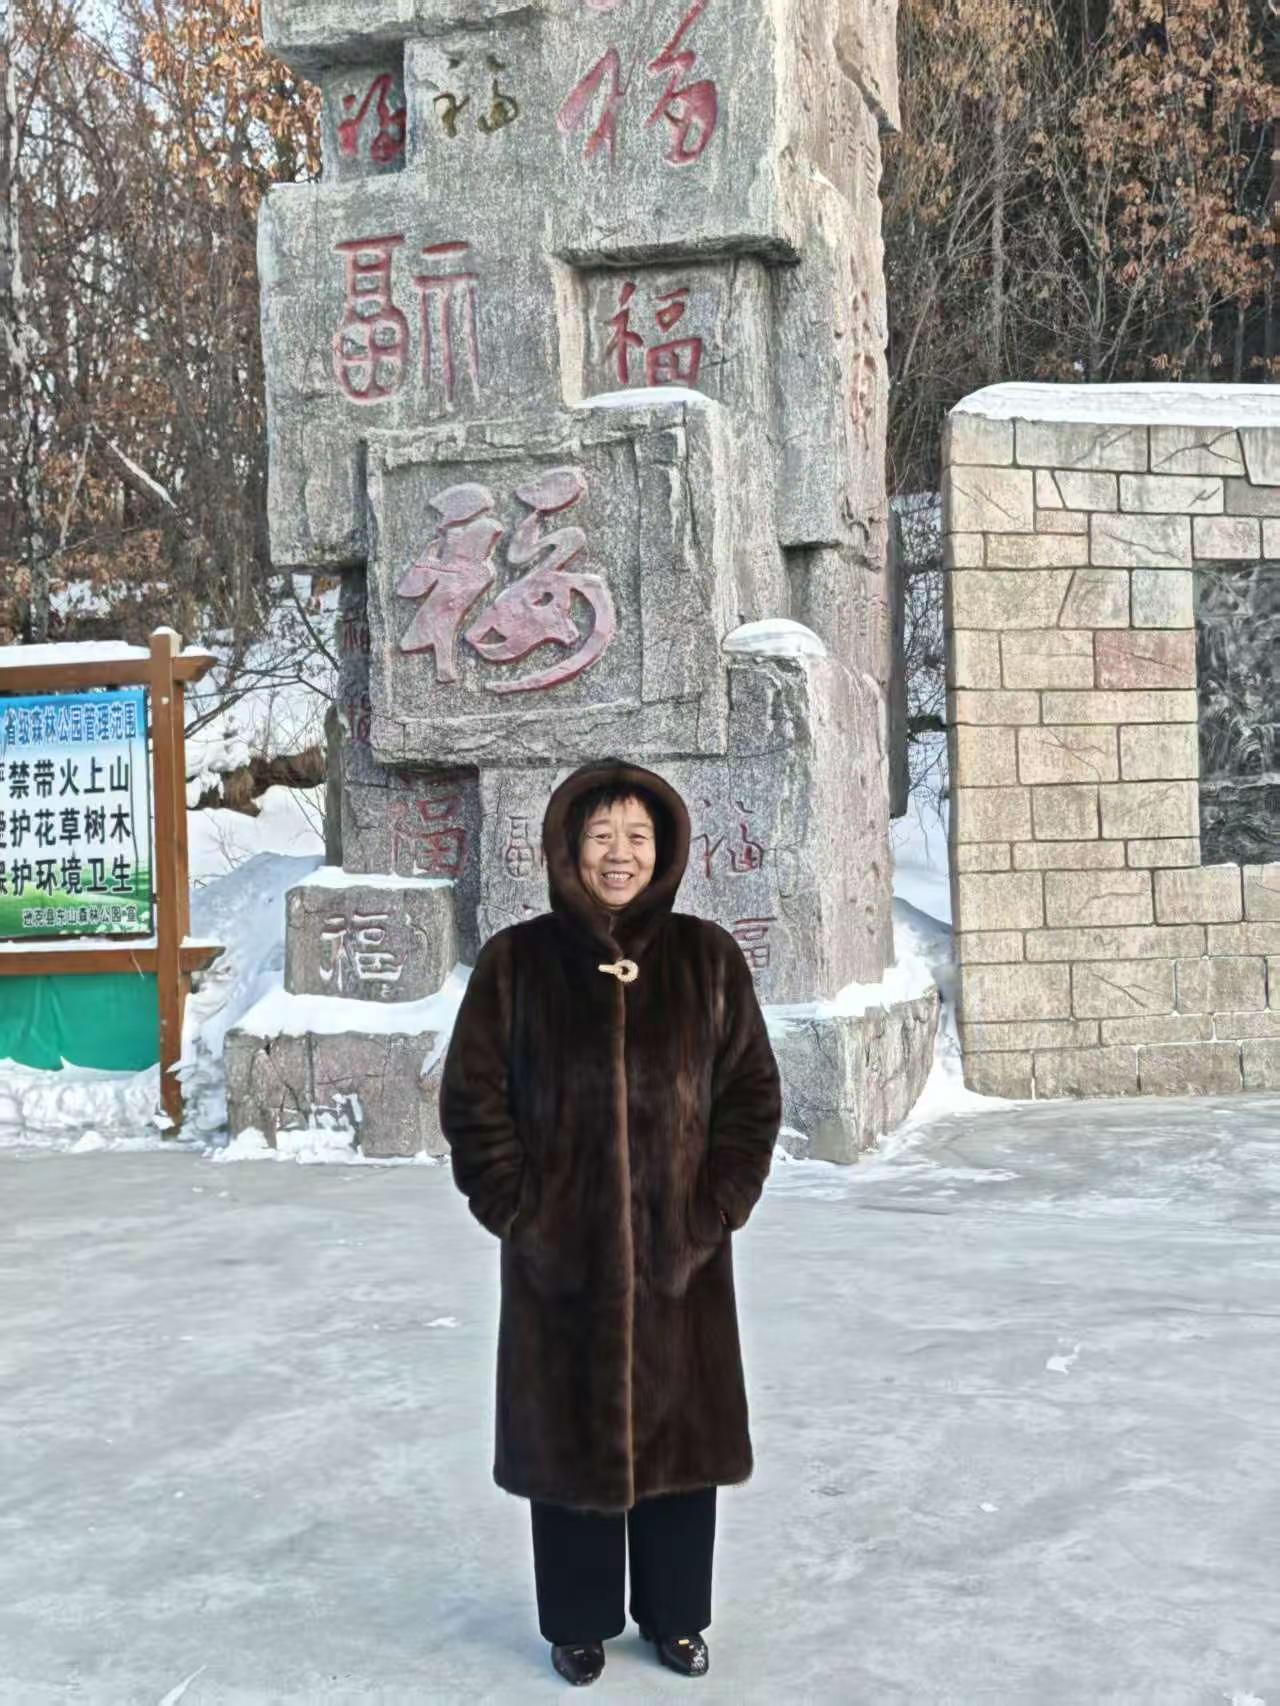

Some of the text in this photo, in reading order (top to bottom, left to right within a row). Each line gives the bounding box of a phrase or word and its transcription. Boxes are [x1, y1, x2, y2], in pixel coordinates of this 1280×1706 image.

[604, 281, 702, 388] 福
[396, 465, 619, 694] 福
[0, 756, 129, 799] 禁带火上山
[0, 805, 131, 849] 护花草树木
[320, 912, 405, 992] 福
